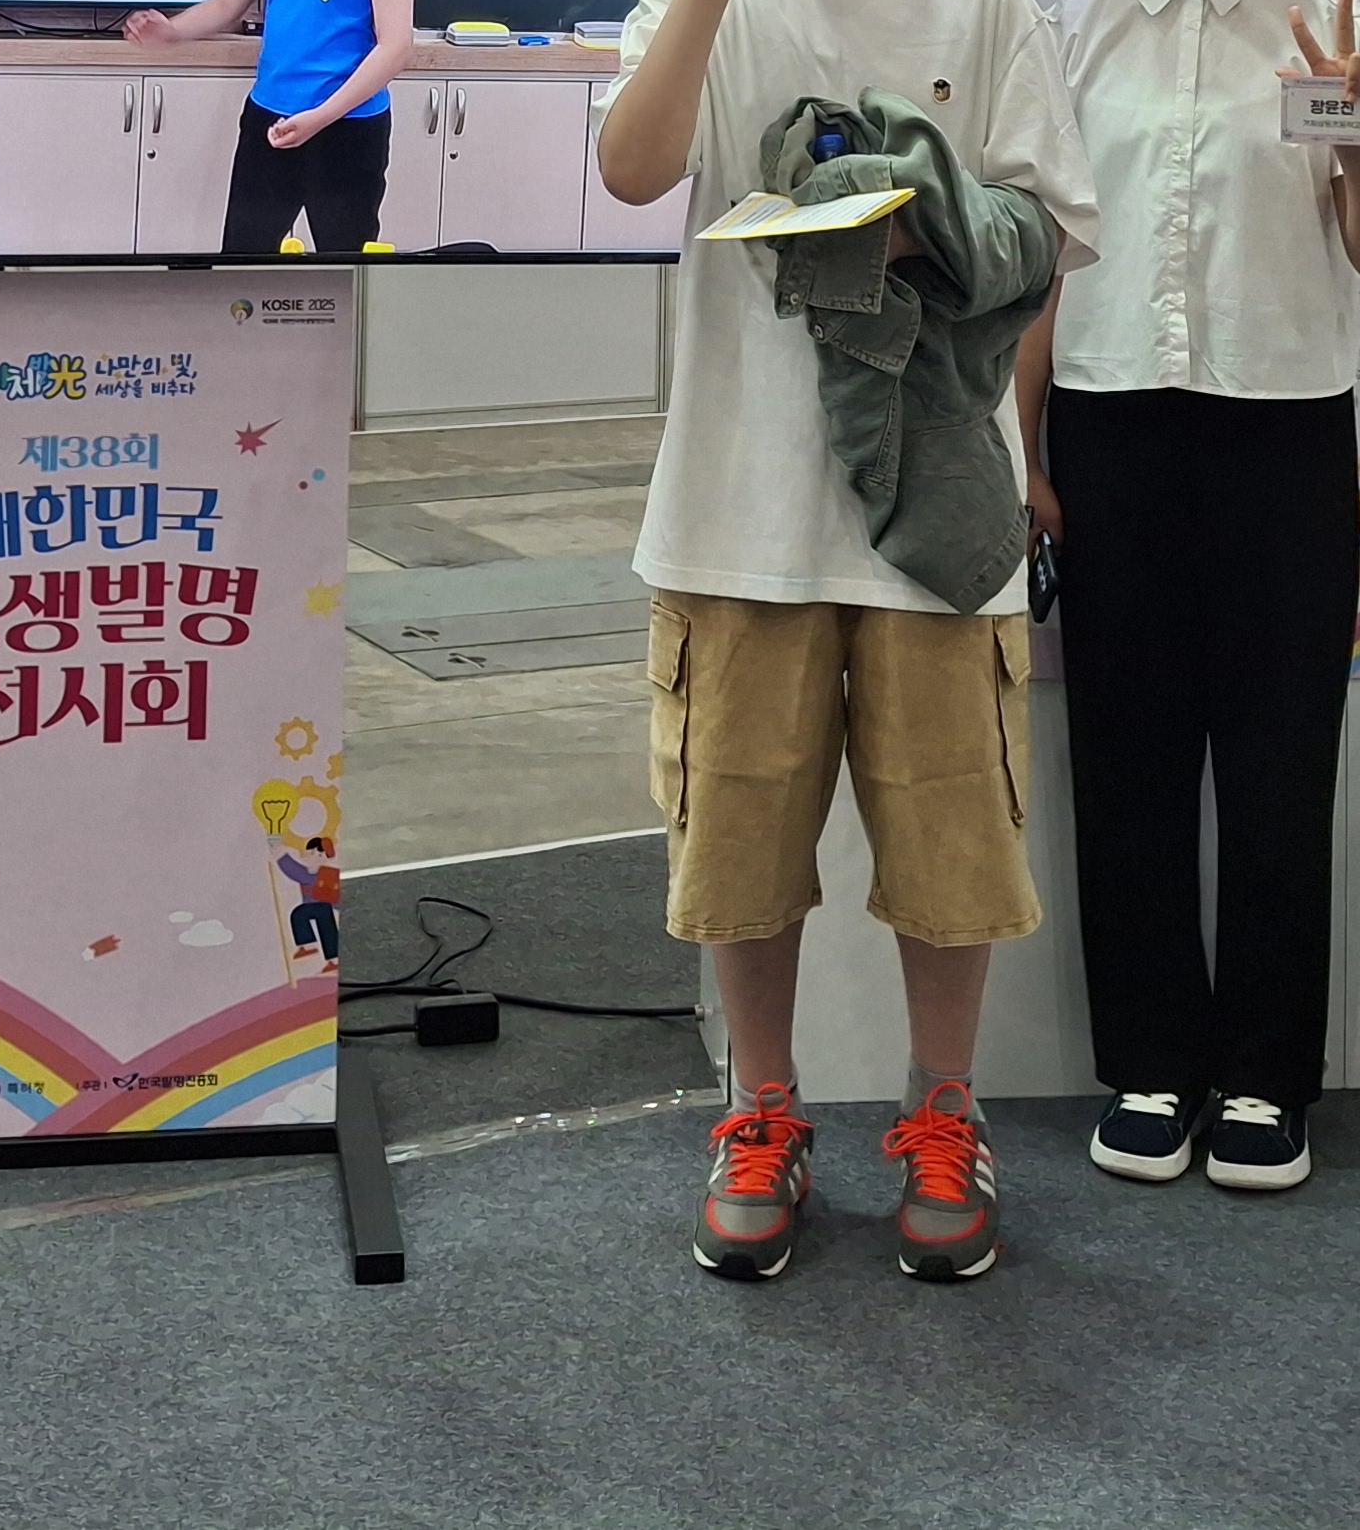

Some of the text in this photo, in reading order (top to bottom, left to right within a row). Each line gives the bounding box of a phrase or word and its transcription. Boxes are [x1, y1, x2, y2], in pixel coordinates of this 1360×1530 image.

[262, 298, 336, 311] KOSIE 2025
[95, 354, 161, 379] 나만의
[95, 378, 196, 399] 세상을 비추다
[18, 431, 159, 472] 제38회
